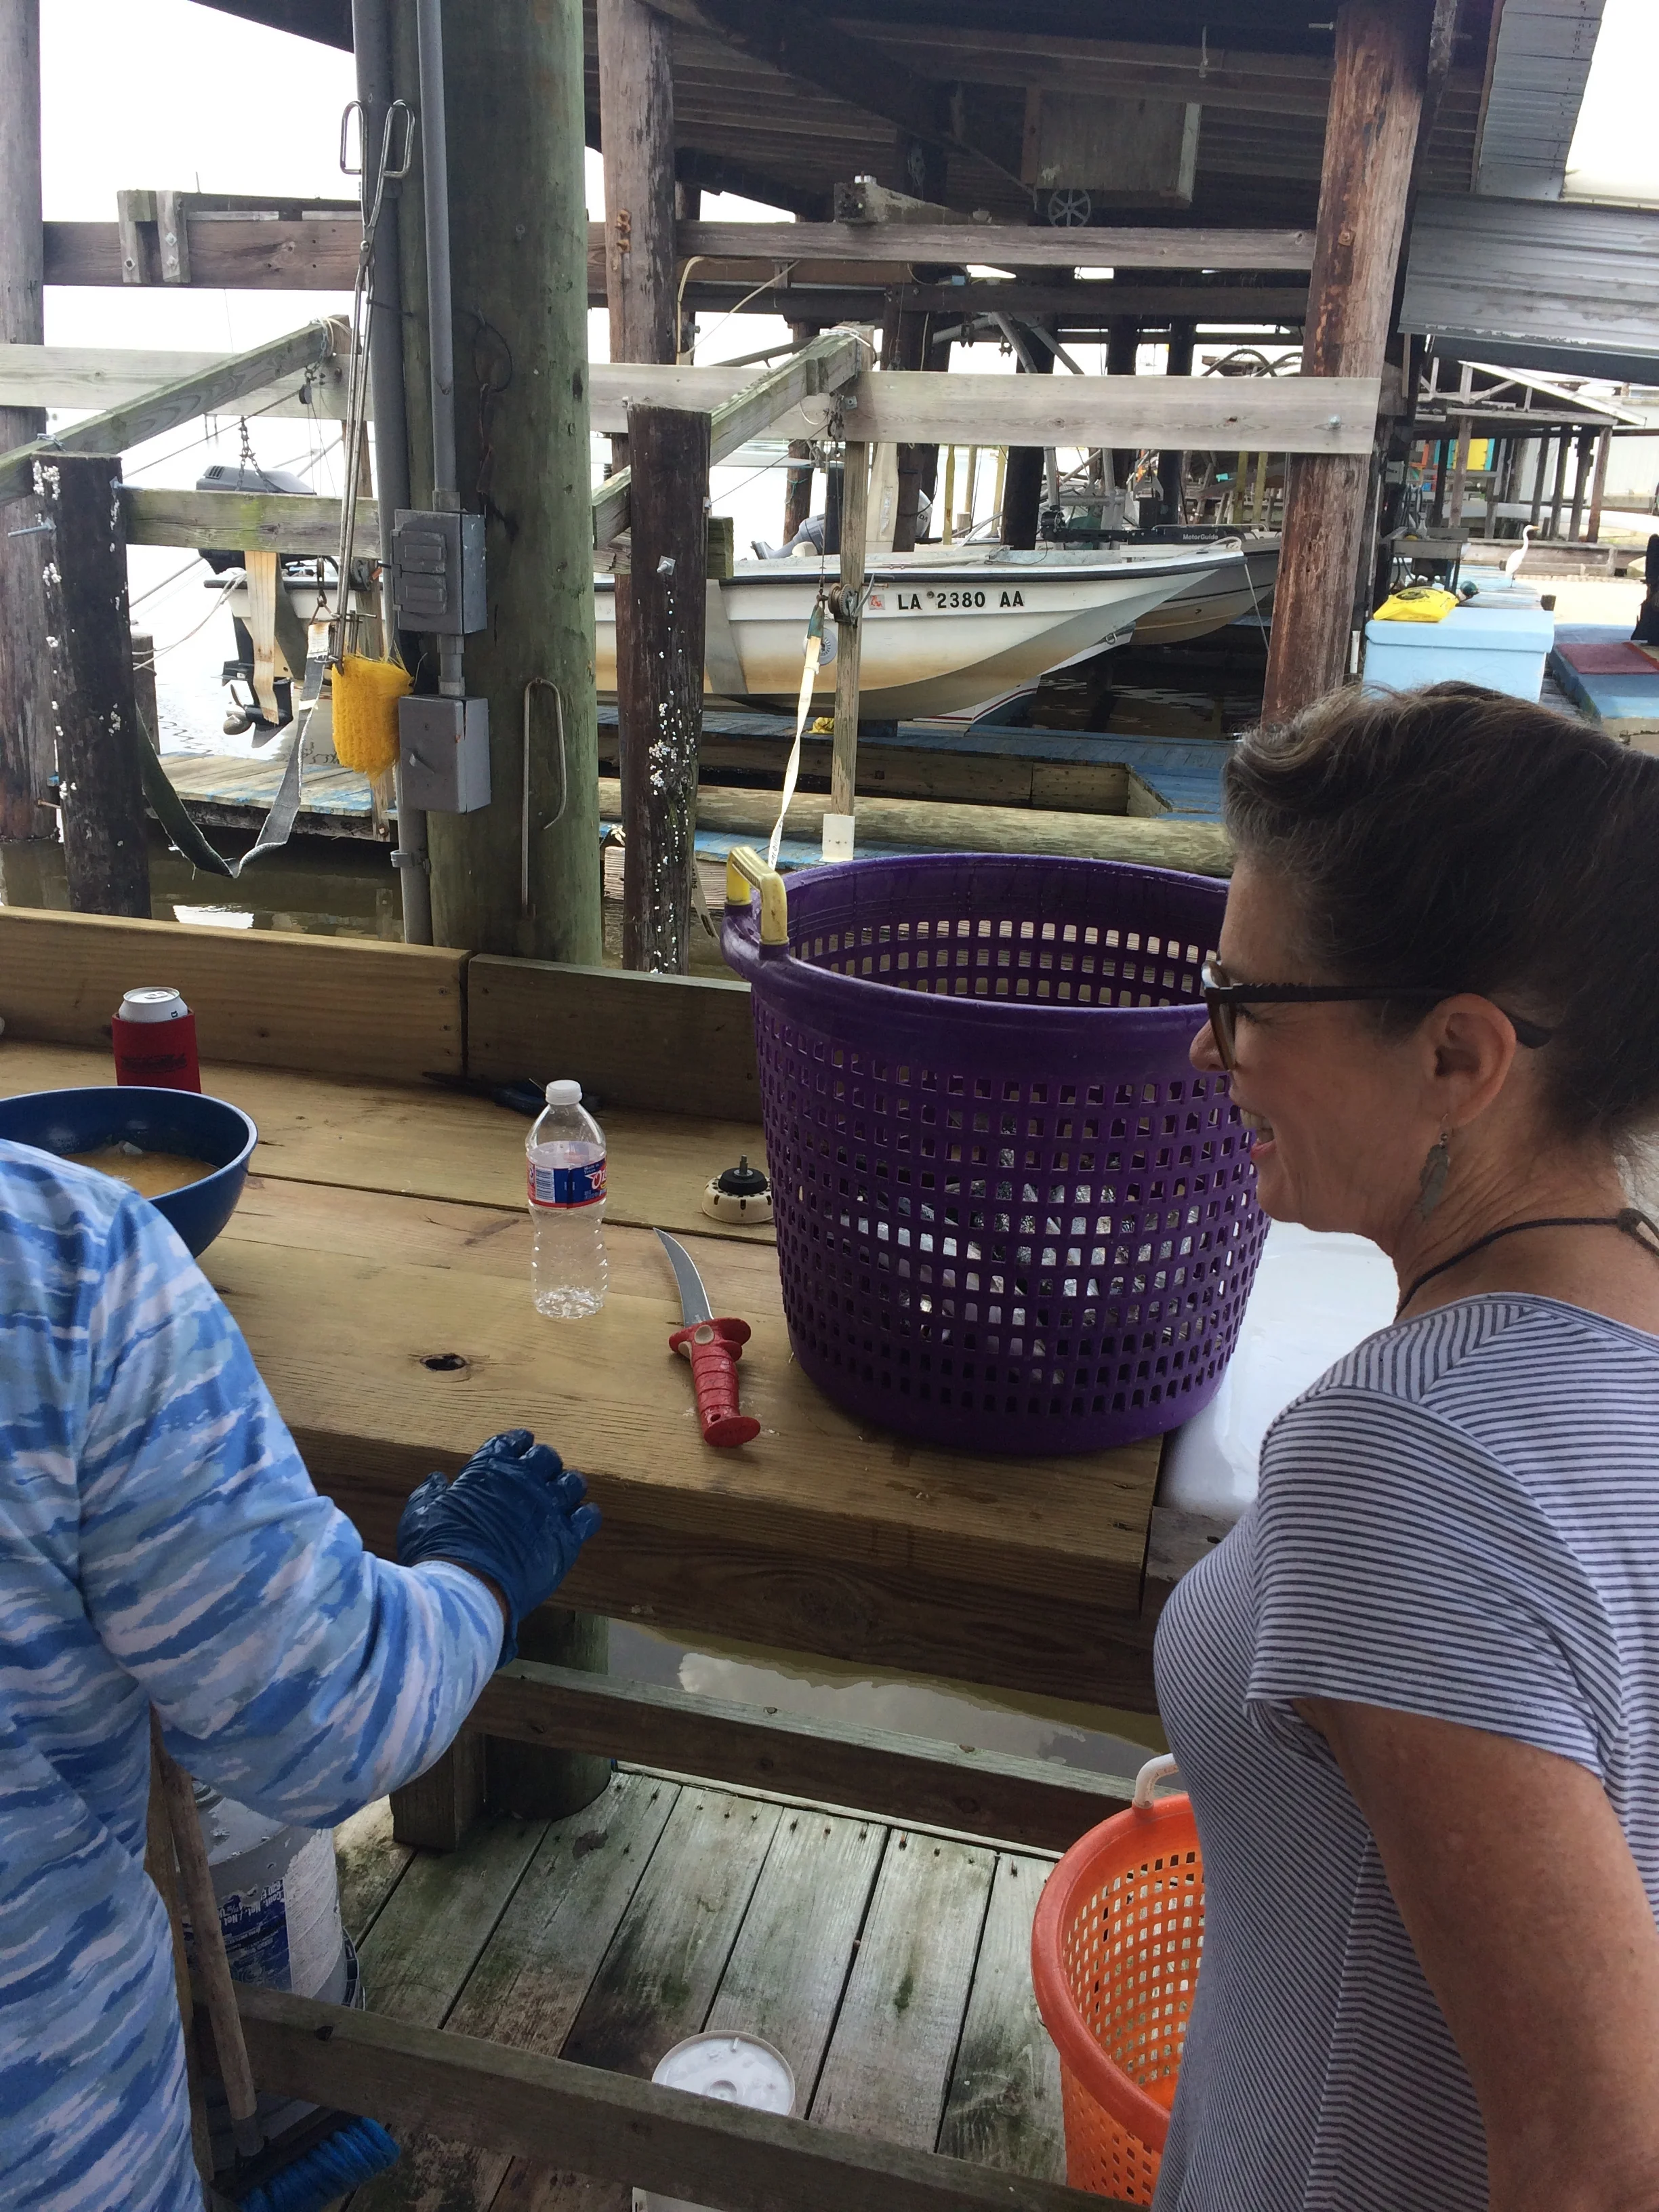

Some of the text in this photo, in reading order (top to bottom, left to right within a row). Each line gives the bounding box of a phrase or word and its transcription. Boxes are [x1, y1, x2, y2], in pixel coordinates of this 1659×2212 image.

[898, 590, 1024, 610] LA 2380 AA
